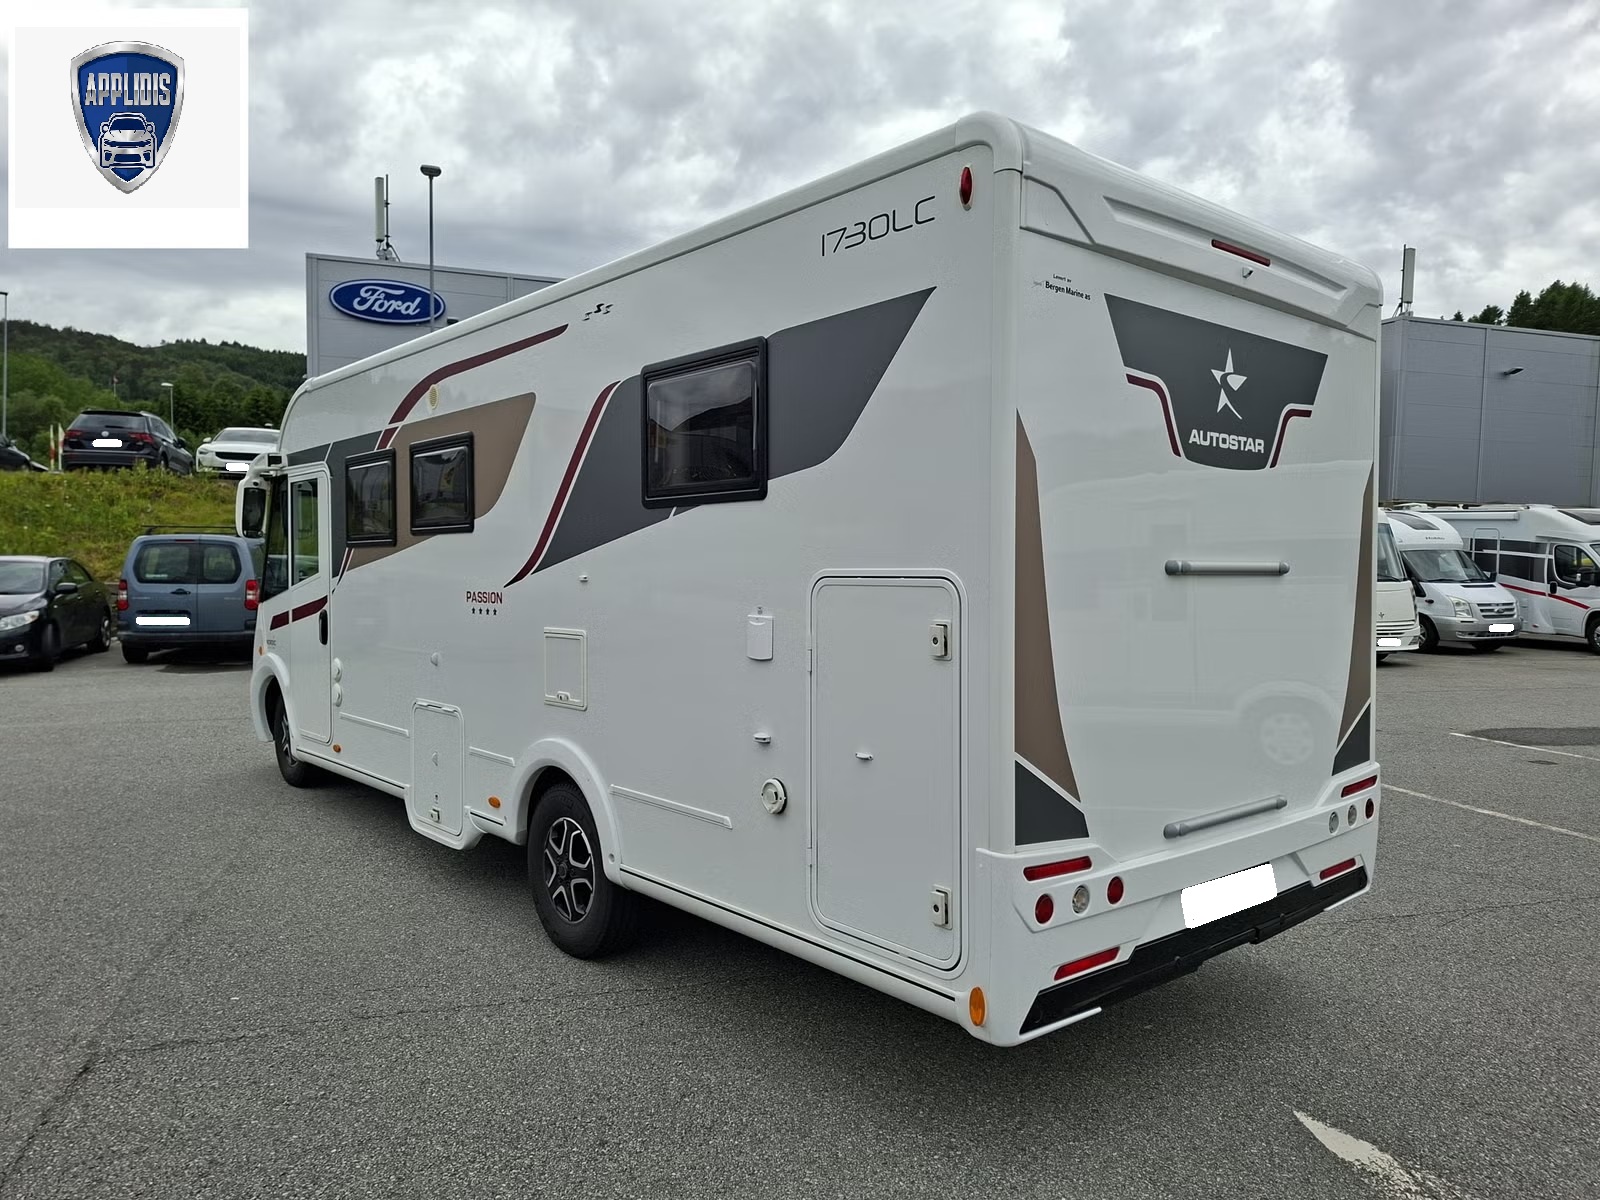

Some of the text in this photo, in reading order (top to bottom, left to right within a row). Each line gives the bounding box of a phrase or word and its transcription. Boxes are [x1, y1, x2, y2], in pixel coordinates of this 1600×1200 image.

[353, 285, 422, 316] Ford
[1045, 280, 1066, 294] Bergen
[1065, 286, 1084, 299] Marine
[1084, 293, 1091, 301] as
[1188, 428, 1265, 454] AUTOSTAR
[466, 590, 503, 604] PASSION
